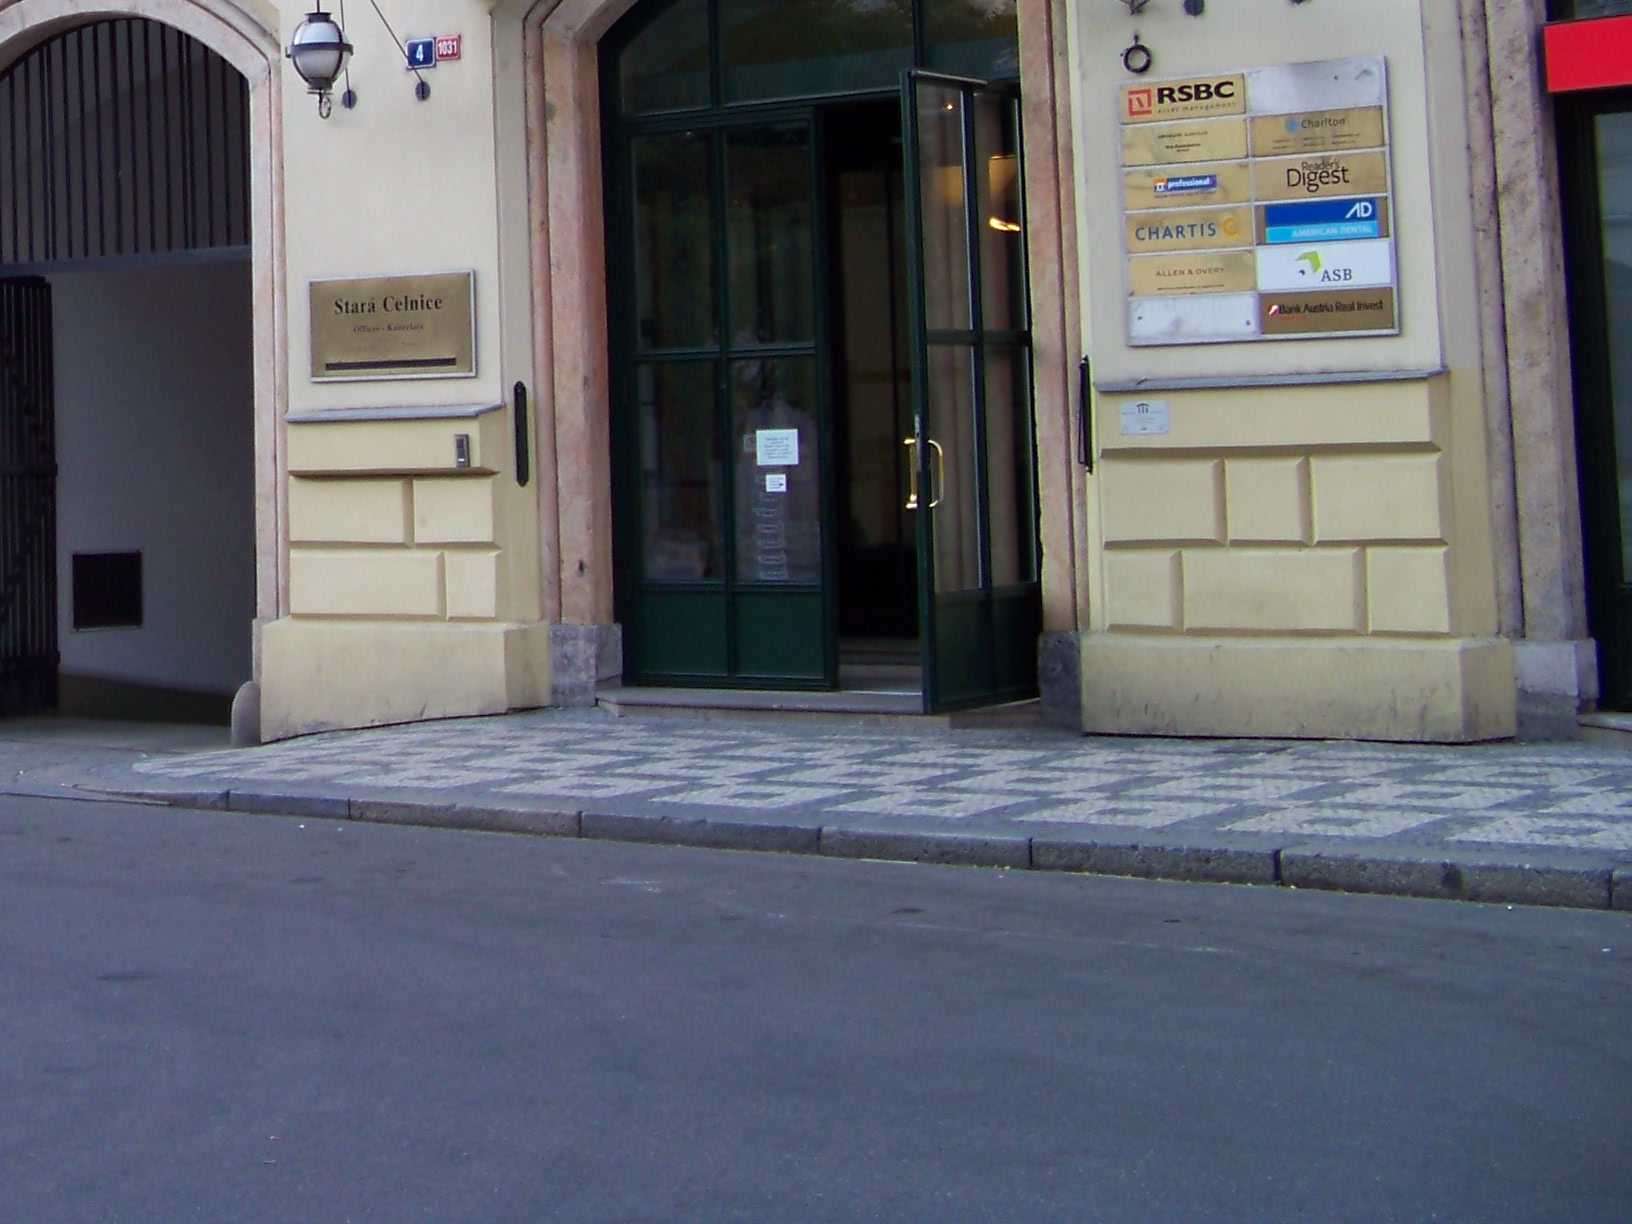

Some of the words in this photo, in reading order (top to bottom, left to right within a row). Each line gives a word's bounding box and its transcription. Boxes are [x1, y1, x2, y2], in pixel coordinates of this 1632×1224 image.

[415, 44, 424, 62] 4
[437, 40, 457, 55] 1031
[1156, 80, 1235, 105] RSBC
[1300, 117, 1346, 130] Charlton
[1167, 177, 1210, 190] professional
[1287, 166, 1350, 193] Digest
[1134, 223, 1217, 241] CHARTIS
[1292, 226, 1338, 238] AMERICAN
[1340, 225, 1372, 235] DENTAL
[1156, 269, 1186, 277] ALLEN
[1195, 266, 1225, 275] OVERY
[1320, 269, 1353, 283] ASB
[334, 297, 376, 315] Stará
[382, 294, 443, 313] Celnice
[1279, 303, 1301, 315] Bank
[1303, 302, 1334, 314] Austria
[1335, 301, 1355, 312] Real
[1356, 299, 1383, 311] Invest
